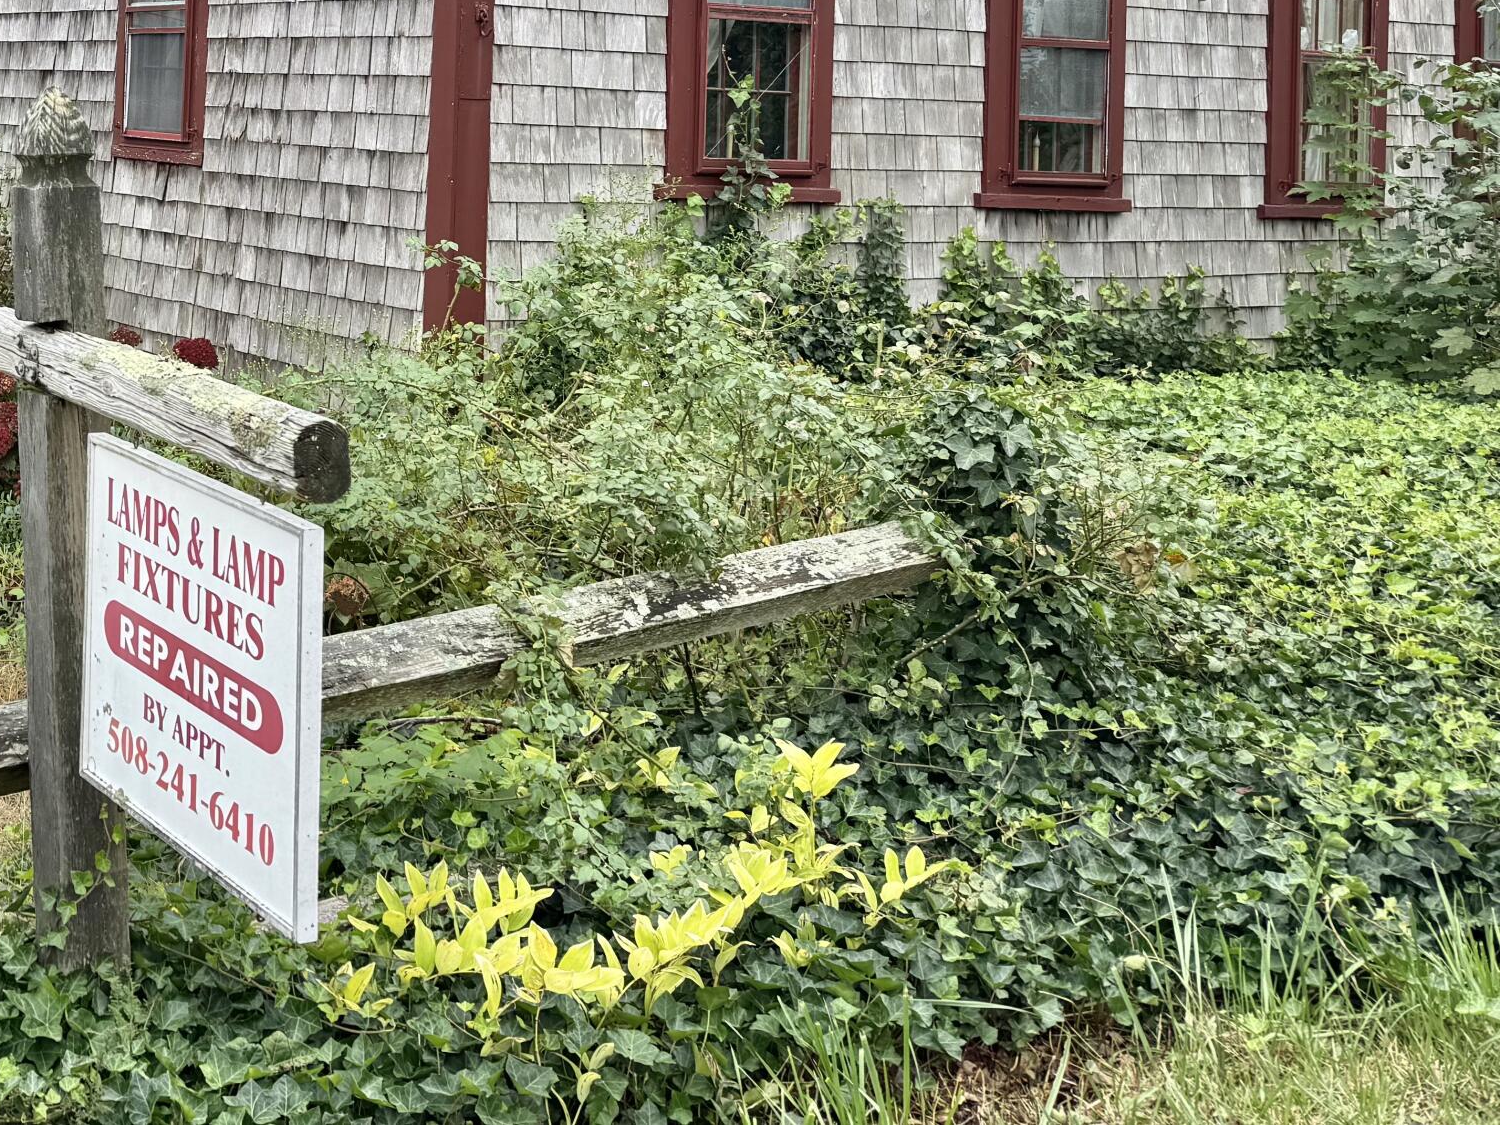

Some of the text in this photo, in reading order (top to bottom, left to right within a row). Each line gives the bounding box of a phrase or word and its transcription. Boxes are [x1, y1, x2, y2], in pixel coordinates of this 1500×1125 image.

[107, 476, 285, 608] LAMPS & LAMP
[116, 541, 265, 661] FIXTURES
[118, 613, 263, 733] REPAIRED
[106, 716, 275, 868] 508-241-6410
[142, 693, 230, 777] BY APPT.
